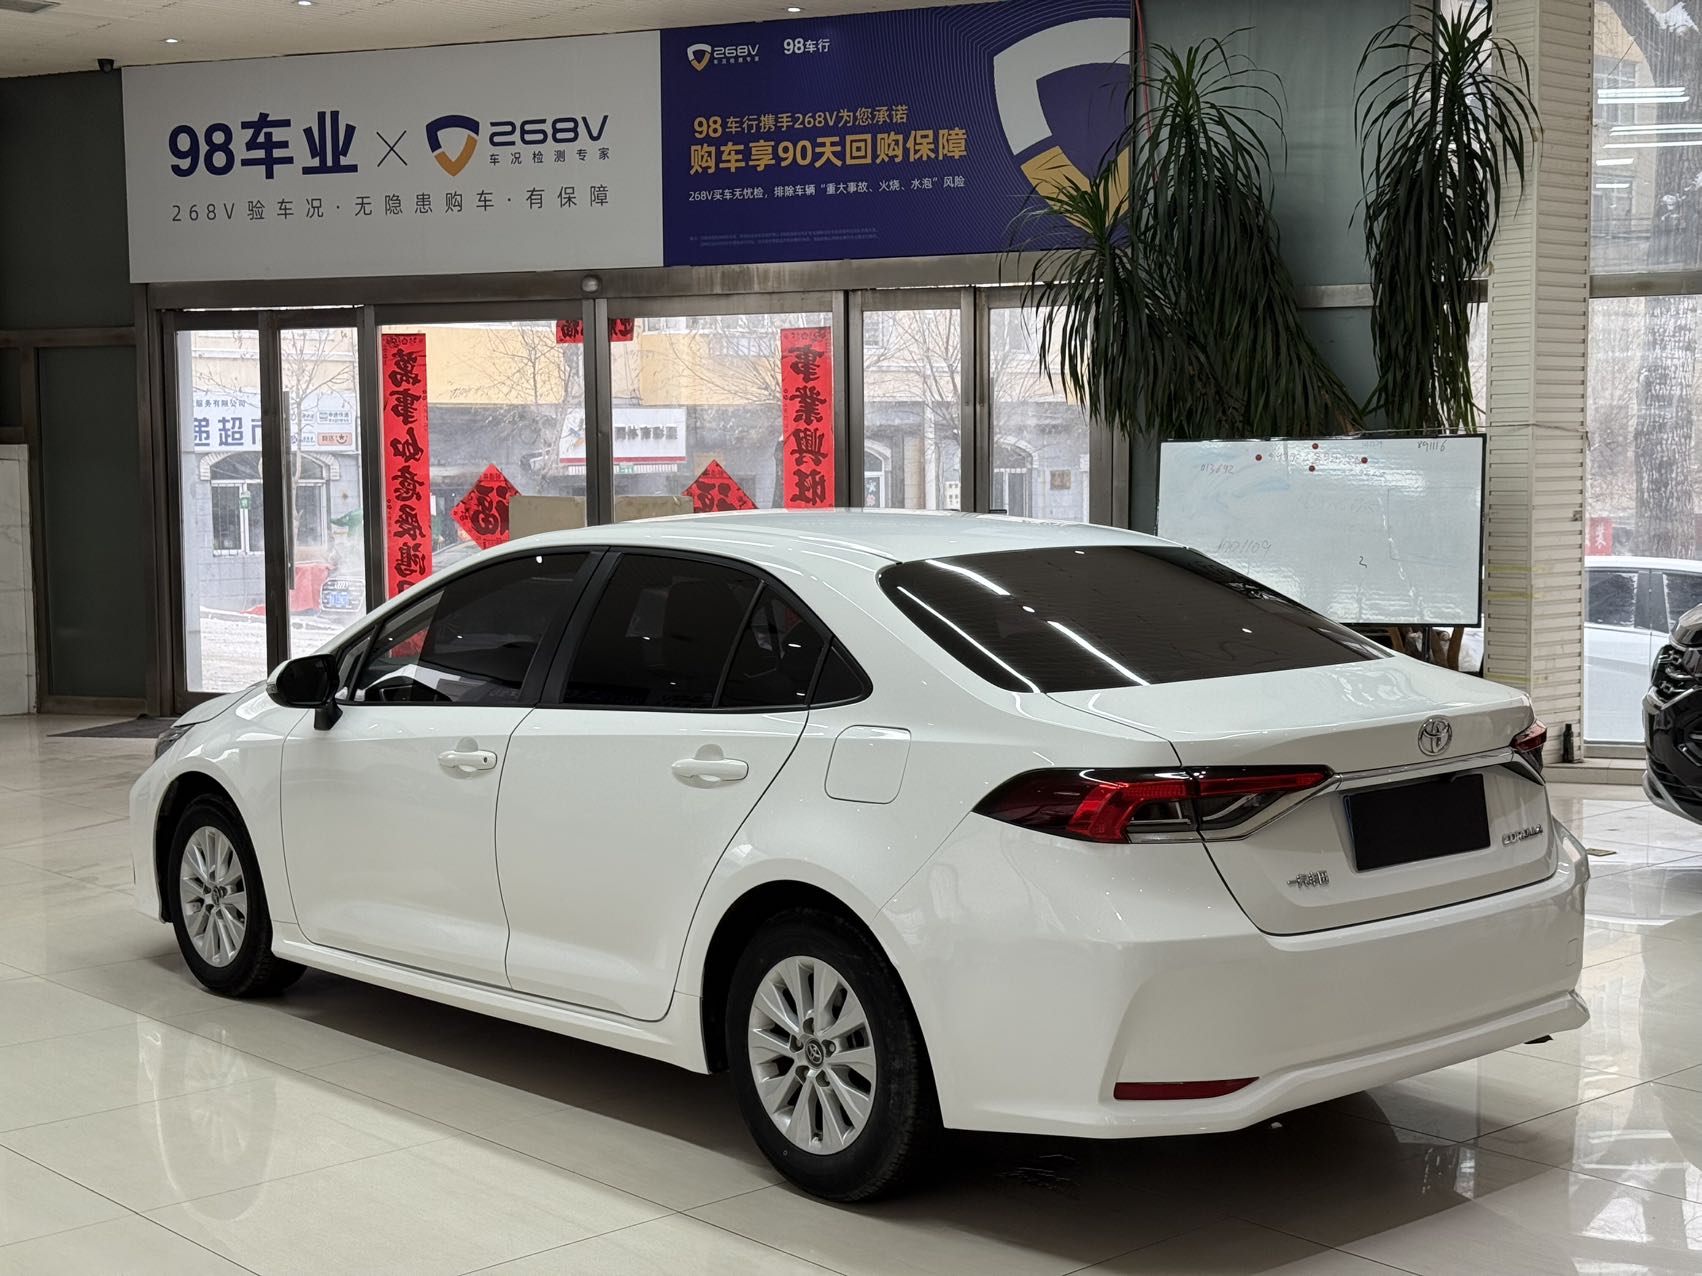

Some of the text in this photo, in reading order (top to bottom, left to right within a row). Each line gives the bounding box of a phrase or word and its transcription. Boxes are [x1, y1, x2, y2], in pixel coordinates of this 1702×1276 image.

[713, 44, 759, 58] 268V
[783, 38, 830, 55] 98车行
[488, 114, 610, 148] 268V
[693, 104, 909, 139] 98车行携手268V为您承诺
[168, 110, 359, 181] 98车业
[489, 147, 610, 167] 车况检测专家
[689, 126, 968, 176] 购车享90天回购保障
